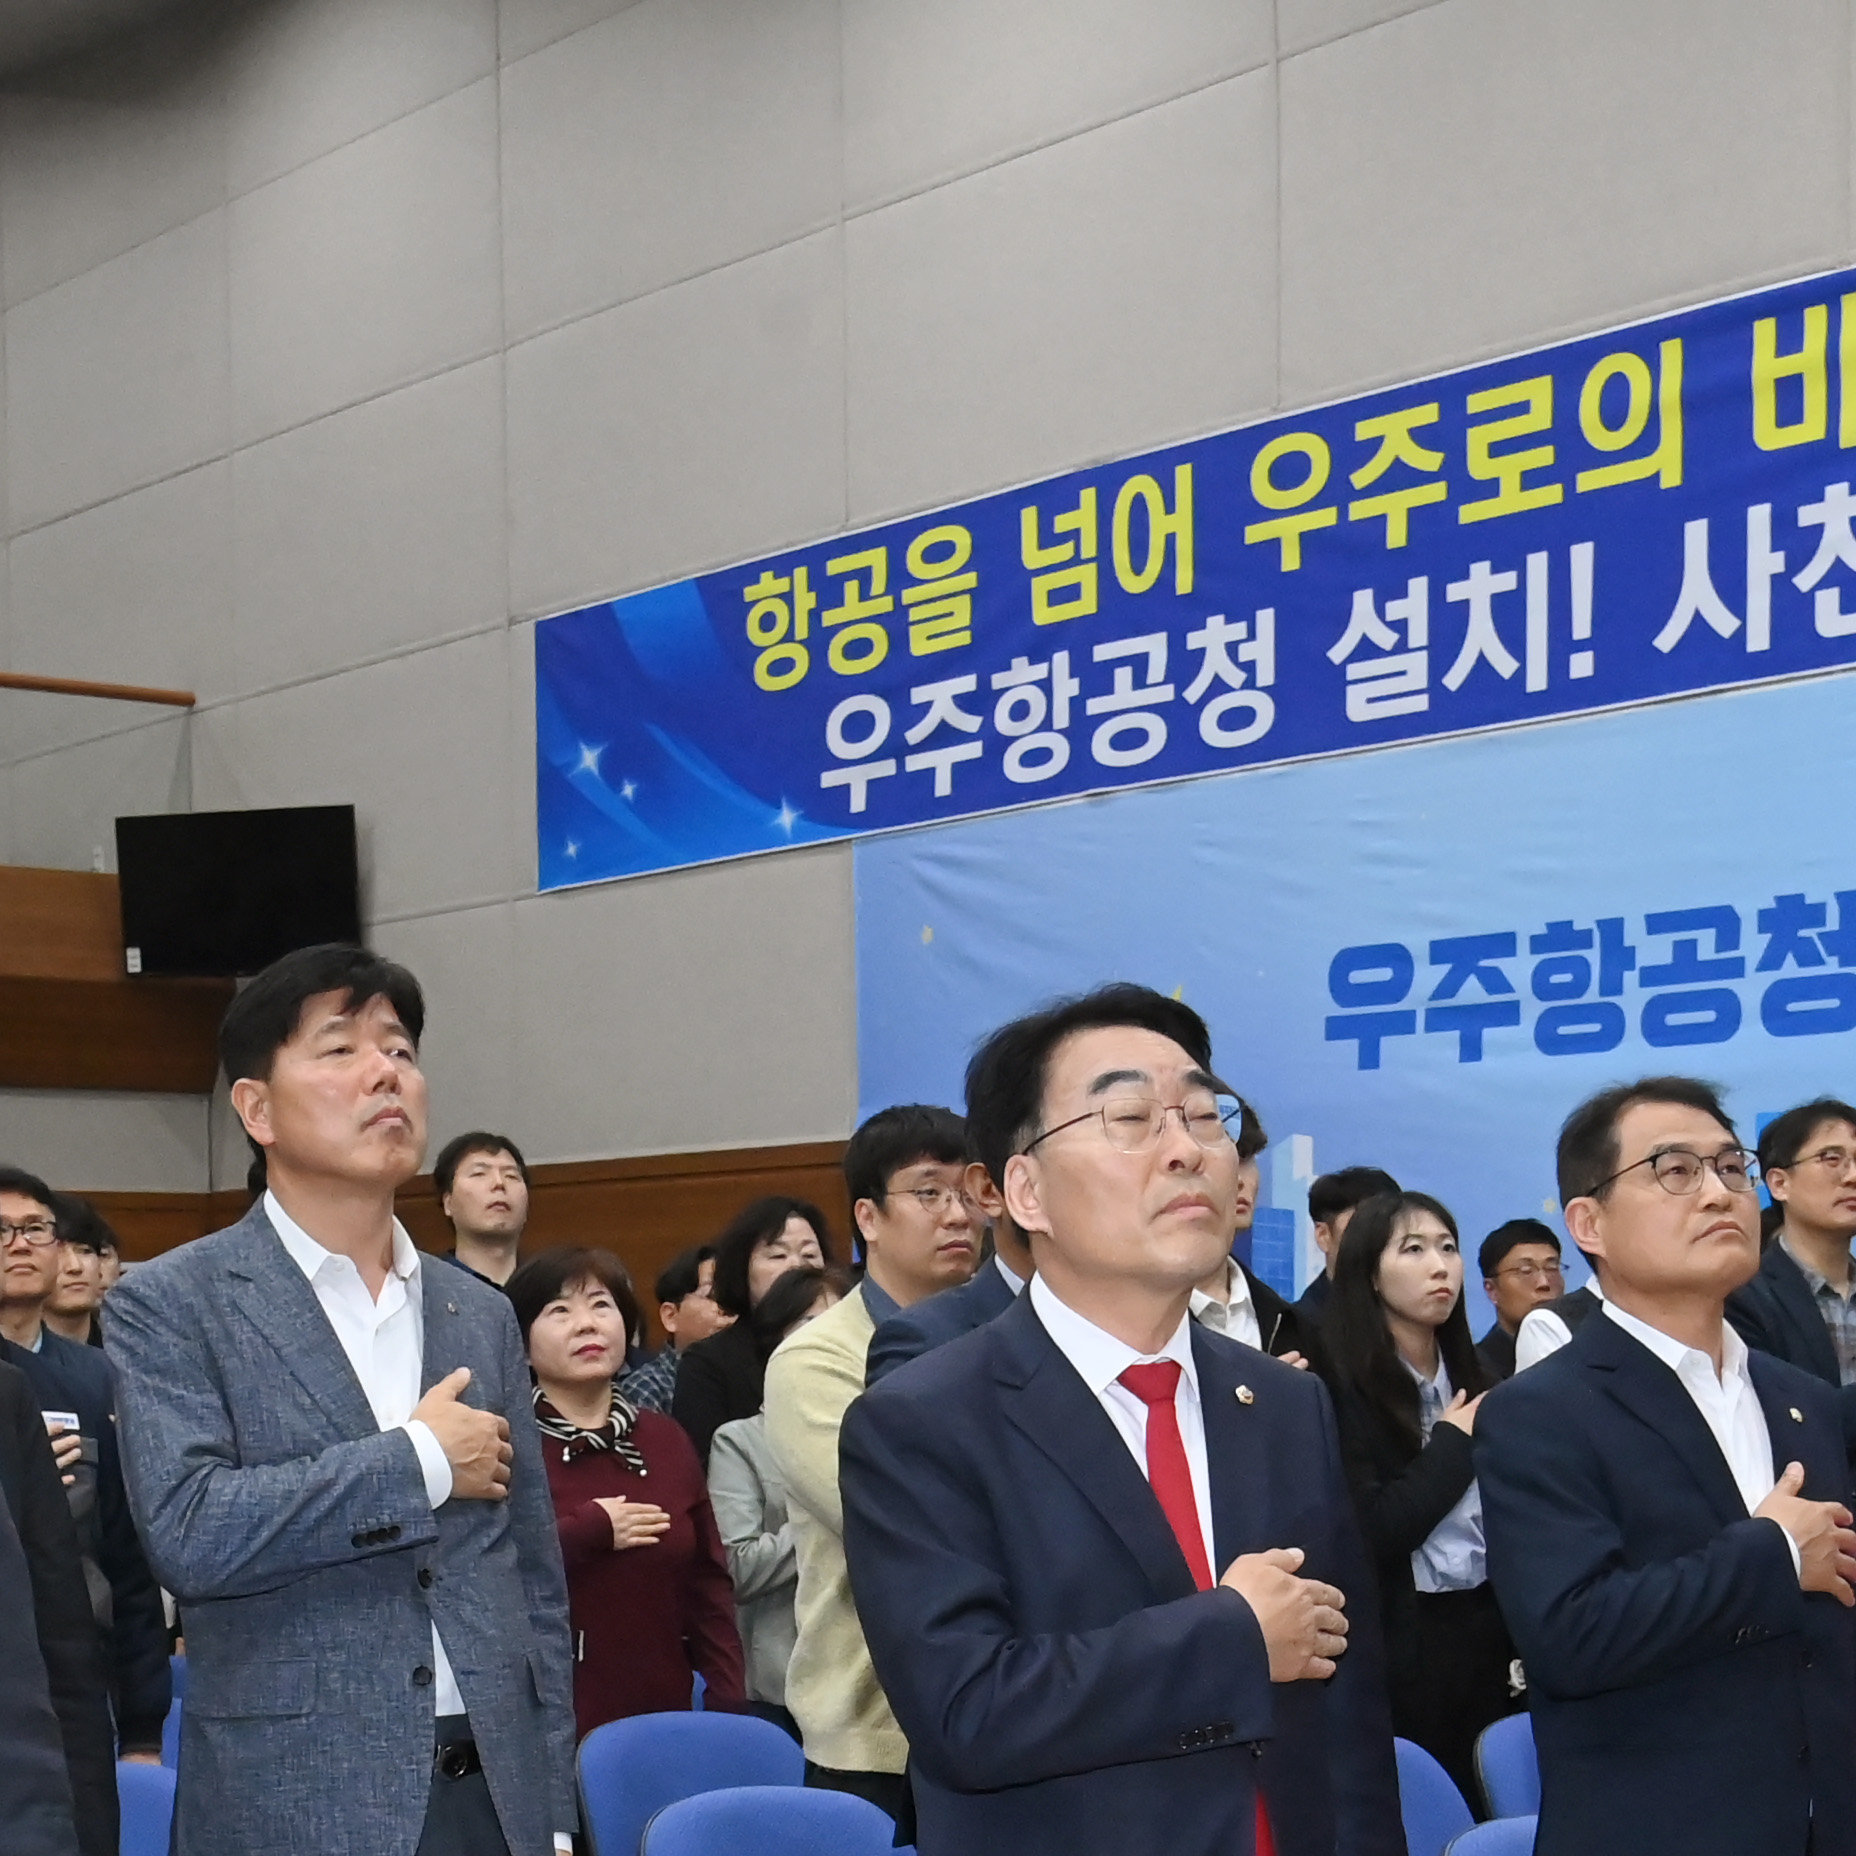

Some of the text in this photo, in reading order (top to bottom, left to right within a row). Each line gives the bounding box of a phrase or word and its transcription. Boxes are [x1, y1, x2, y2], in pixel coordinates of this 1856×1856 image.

[744, 524, 978, 692] 항공을
[1020, 466, 1194, 626] 넘어
[1244, 337, 1684, 572] 우주로의
[819, 606, 1277, 814] 우주항공청
[1327, 541, 1595, 723] 설치!
